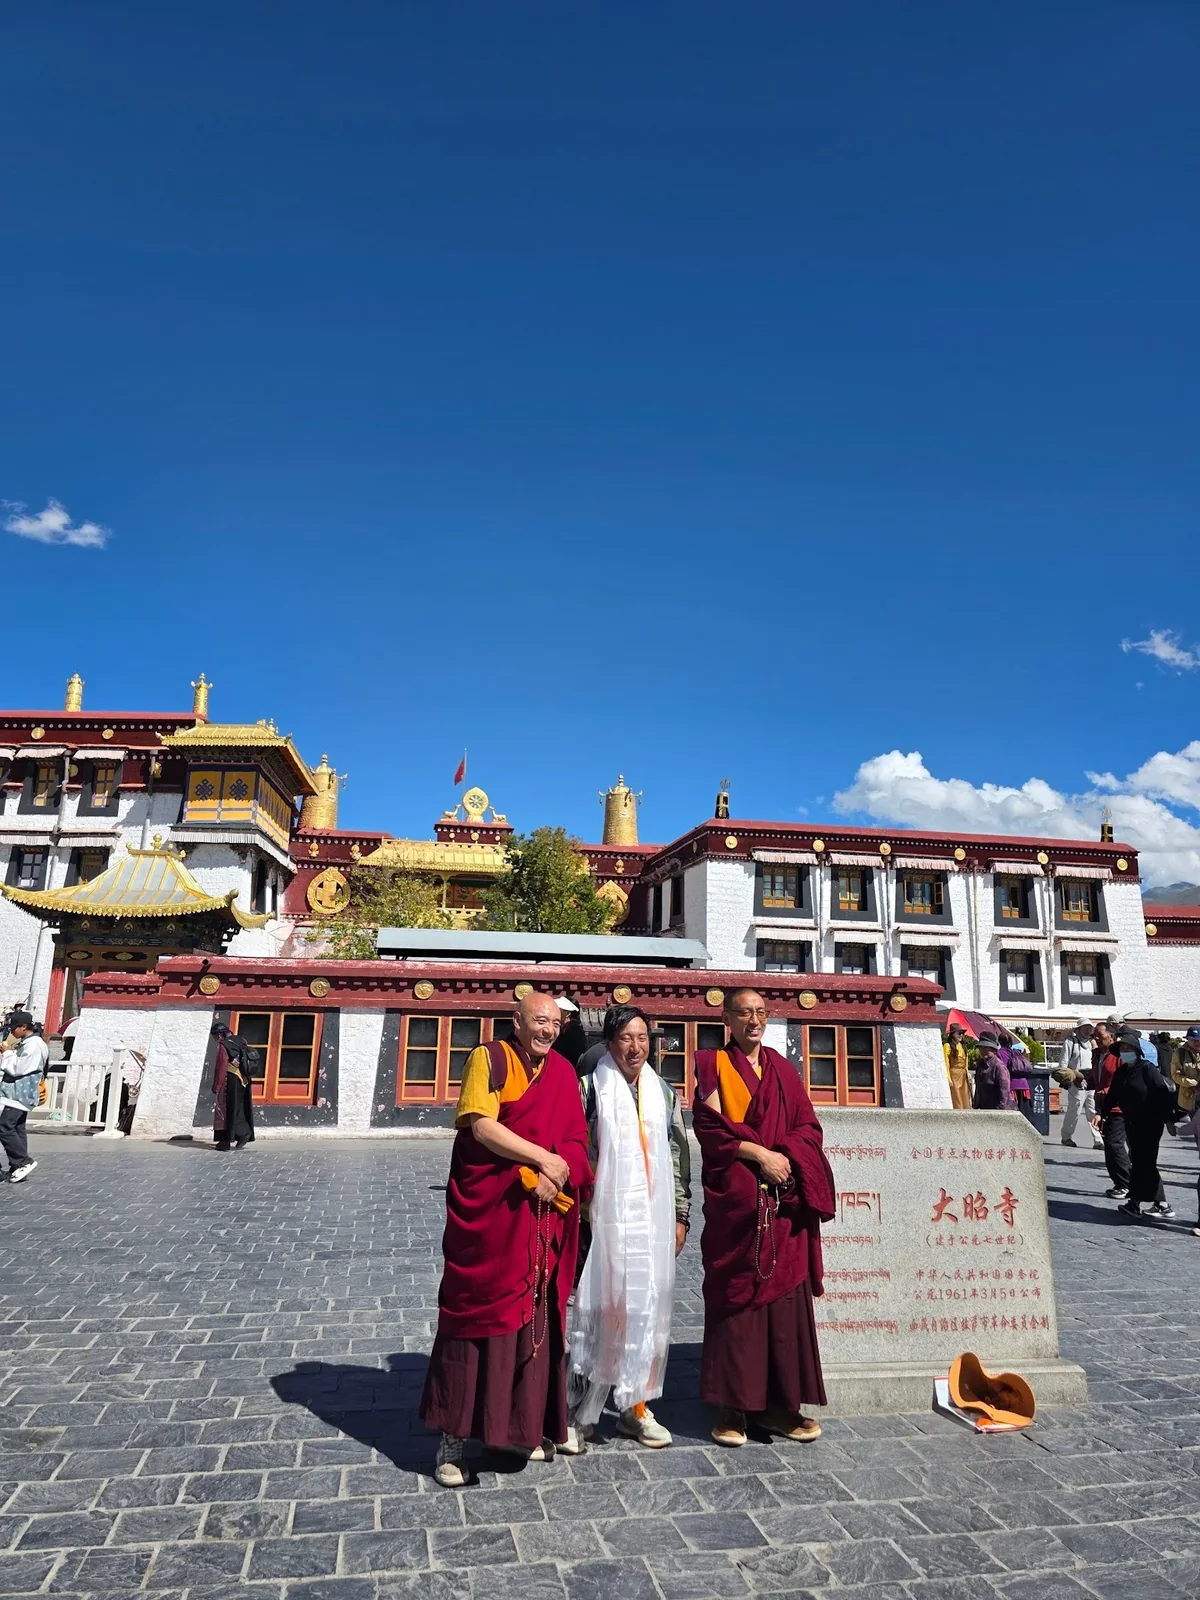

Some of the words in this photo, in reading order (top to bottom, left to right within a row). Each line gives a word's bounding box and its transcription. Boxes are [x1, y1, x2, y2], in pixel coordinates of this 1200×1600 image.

[910, 1146, 1032, 1162] 全国重点文物保护单位
[930, 1186, 1019, 1228] 大昭寺
[925, 1233, 1025, 1247] (建于公元七世纪)
[915, 1268, 1040, 1282] 中华人民共和国国务院
[913, 1286, 1042, 1301] 公元1961年3月5日公布
